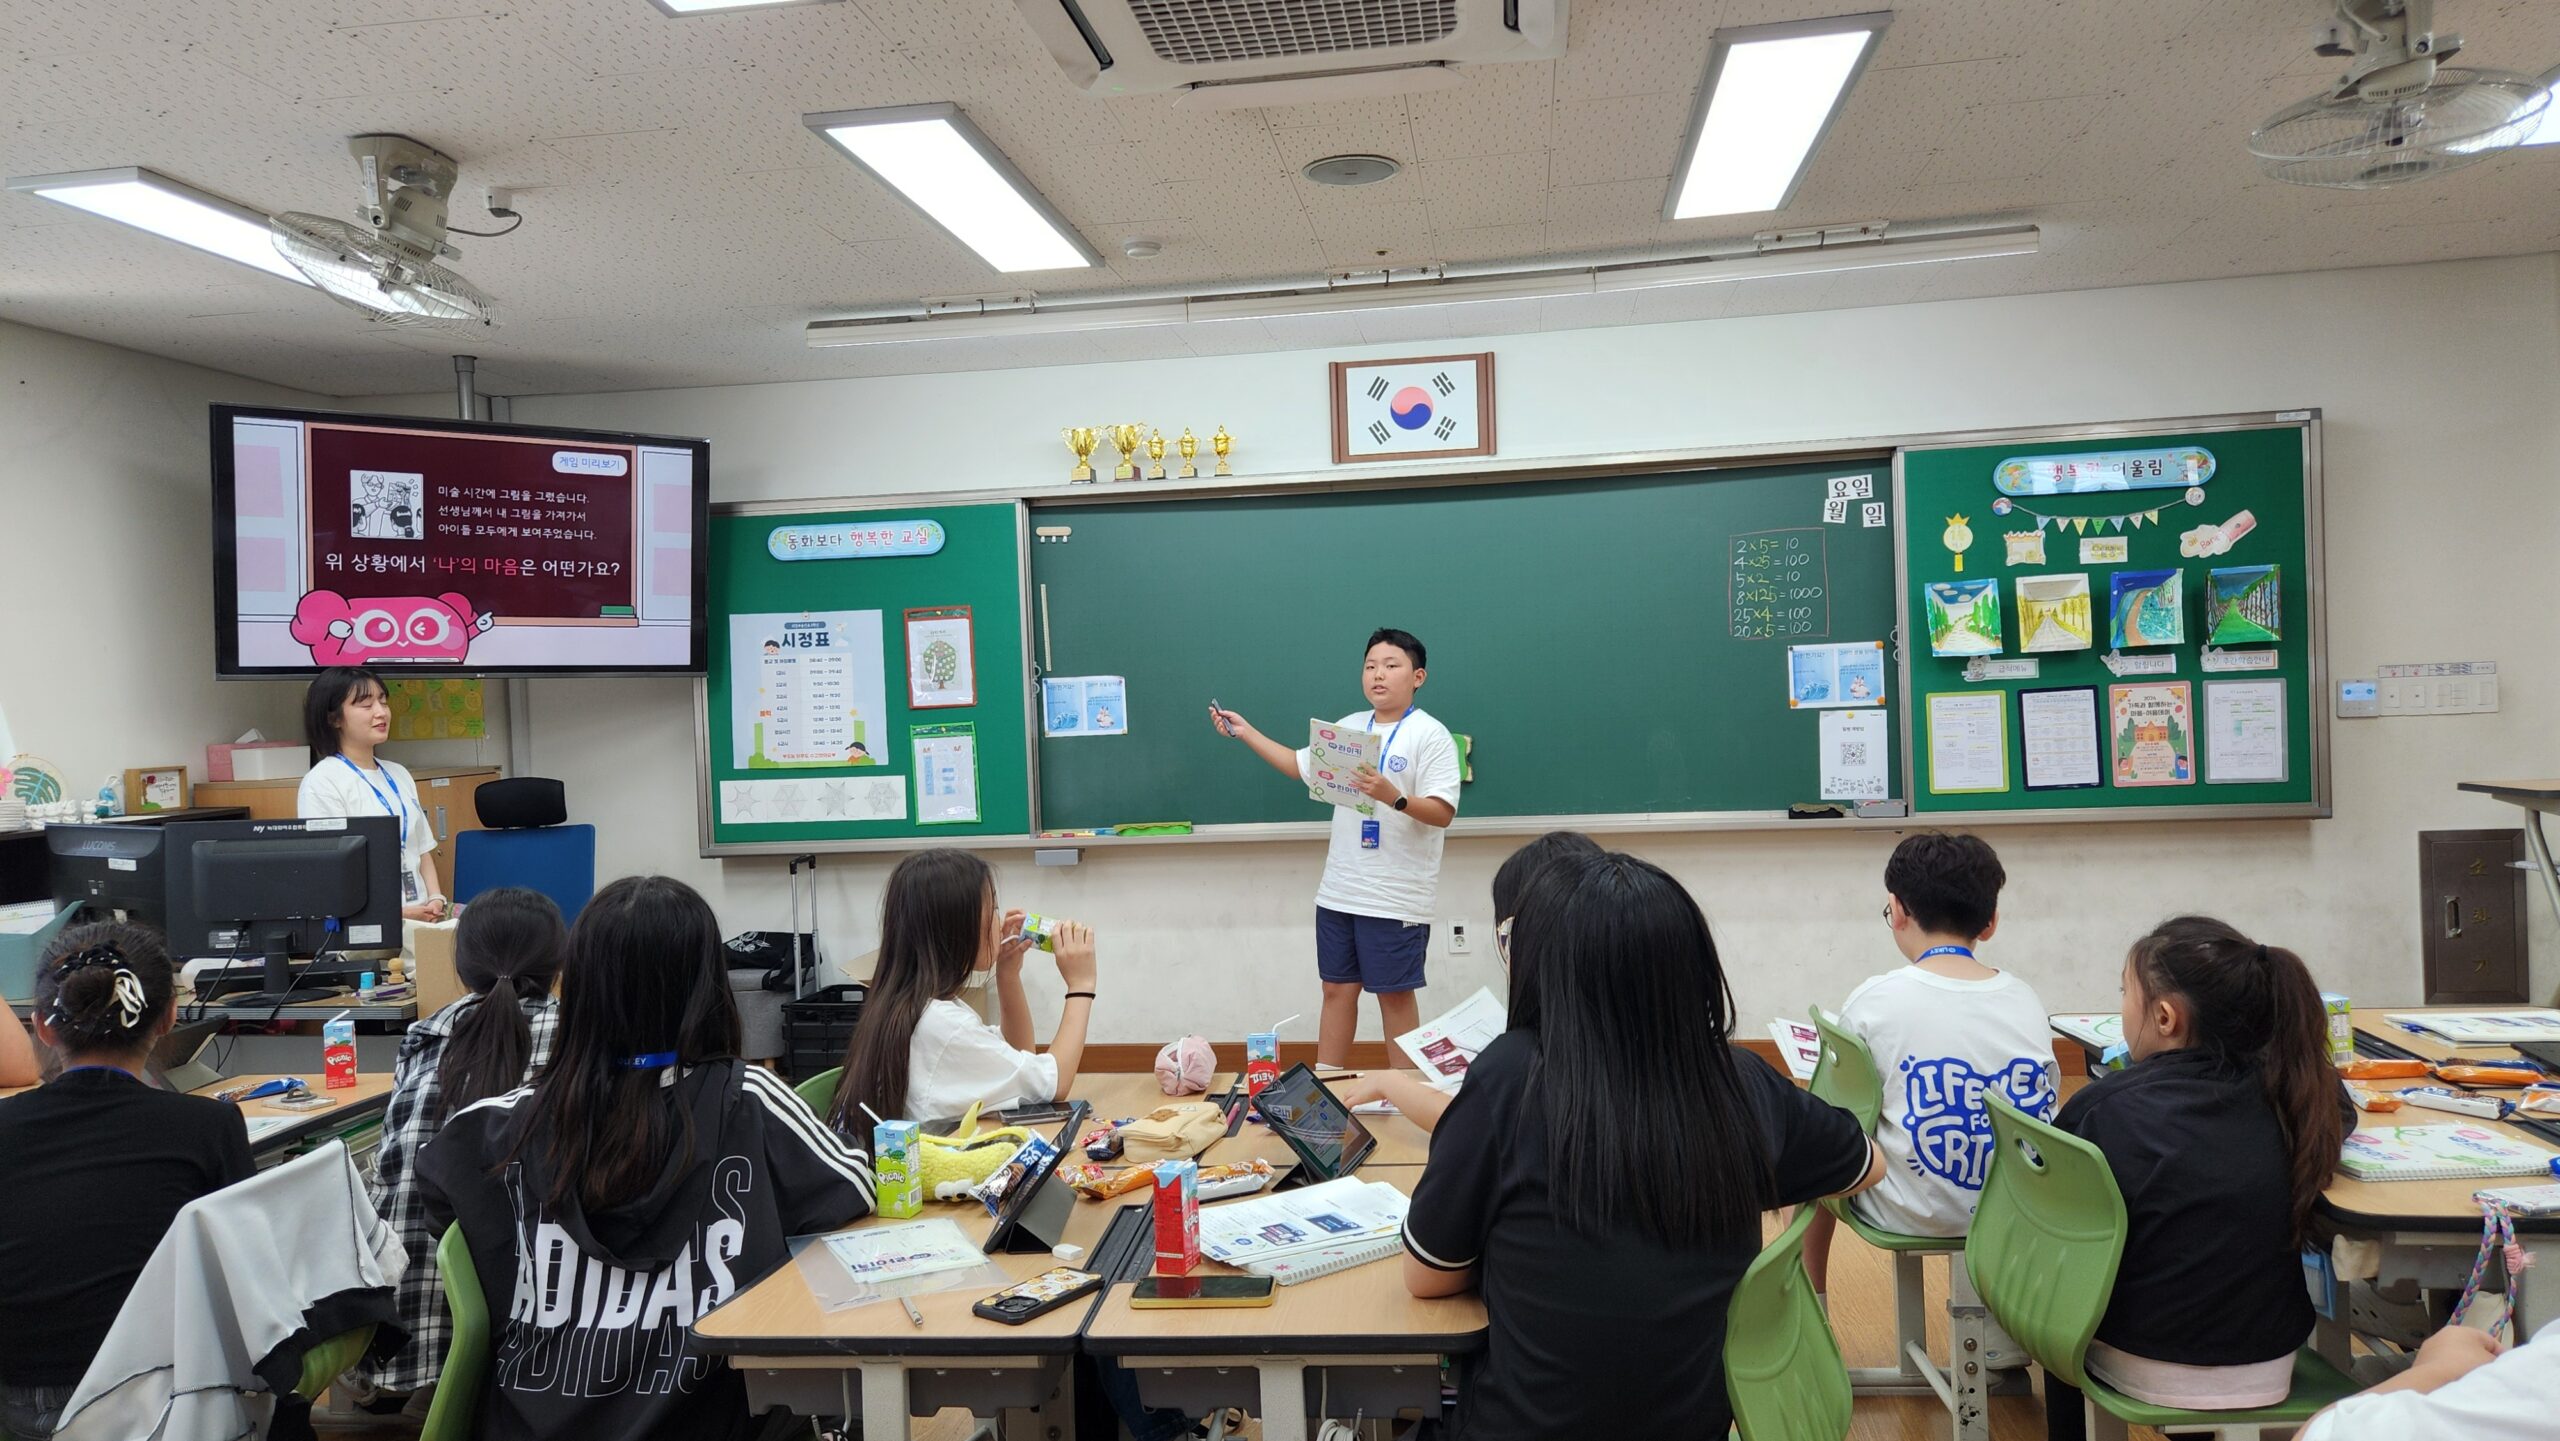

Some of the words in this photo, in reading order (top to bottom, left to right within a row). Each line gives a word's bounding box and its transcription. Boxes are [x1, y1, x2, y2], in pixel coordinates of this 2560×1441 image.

[559, 456, 579, 468] 게임
[581, 457, 621, 471] 미리보기
[438, 486, 460, 498] 미술
[463, 487, 496, 500] 시간에
[500, 489, 532, 501] 그림을
[534, 491, 590, 504] 그렸습니다.
[1832, 477, 1870, 499] 요일
[438, 505, 493, 518] 선생님께서
[497, 507, 507, 519] 내
[510, 509, 542, 520] 그림을
[545, 510, 586, 522] 가져가서
[1828, 500, 1844, 520] 월
[1865, 505, 1883, 525] 일
[438, 523, 472, 536] 아이들
[474, 526, 518, 537] 모두에게
[521, 527, 597, 540] 보여주었습니다.
[787, 533, 842, 551] 동화보다
[850, 530, 894, 547] 행복한
[901, 527, 929, 545] 교실
[1785, 537, 1799, 551] 10
[325, 553, 343, 572] 위
[351, 554, 426, 573] 상황에서
[485, 558, 537, 576] 마음은
[542, 559, 621, 578] 어떤가요?
[1784, 552, 1810, 567] 100
[1786, 571, 1801, 583] 10
[1789, 586, 1823, 600] 1000
[1788, 606, 1812, 621] 100
[1789, 620, 1812, 634] 100
[781, 631, 830, 648] 시정표
[82, 840, 116, 851] LUCOMS
[327, 1054, 353, 1066] Picnic
[1911, 1062, 1985, 1118] LIFE
[878, 1172, 905, 1186] Picnic
